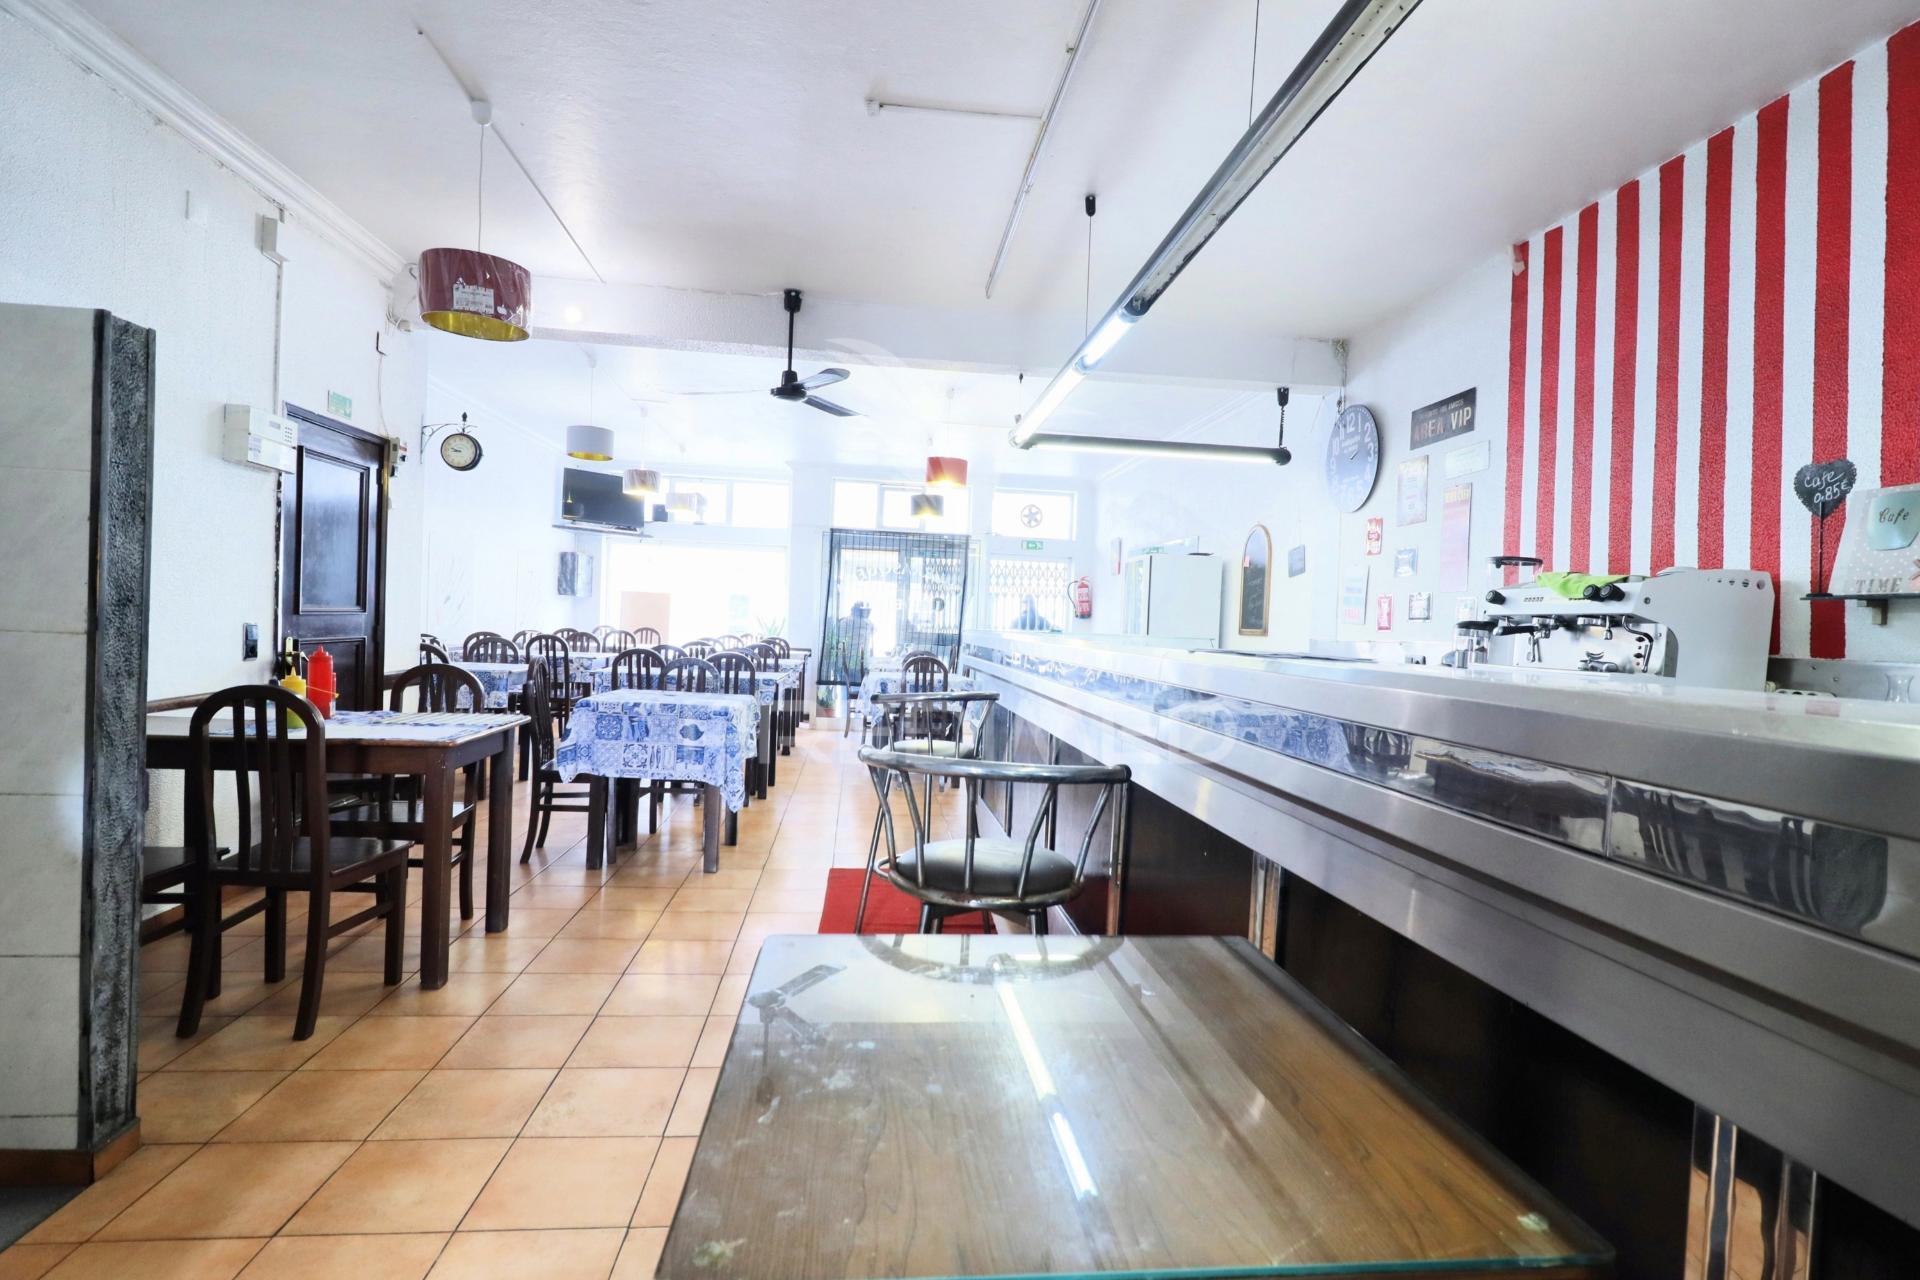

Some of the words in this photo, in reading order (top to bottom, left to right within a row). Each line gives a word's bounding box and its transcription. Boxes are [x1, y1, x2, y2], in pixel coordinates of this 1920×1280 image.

[1346, 412, 1355, 434] 12
[1451, 406, 1472, 431] VIP
[1364, 422, 1371, 443] 2
[1331, 437, 1340, 456] 10
[1368, 442, 1374, 462] 3
[1856, 577, 1903, 593] TIME
